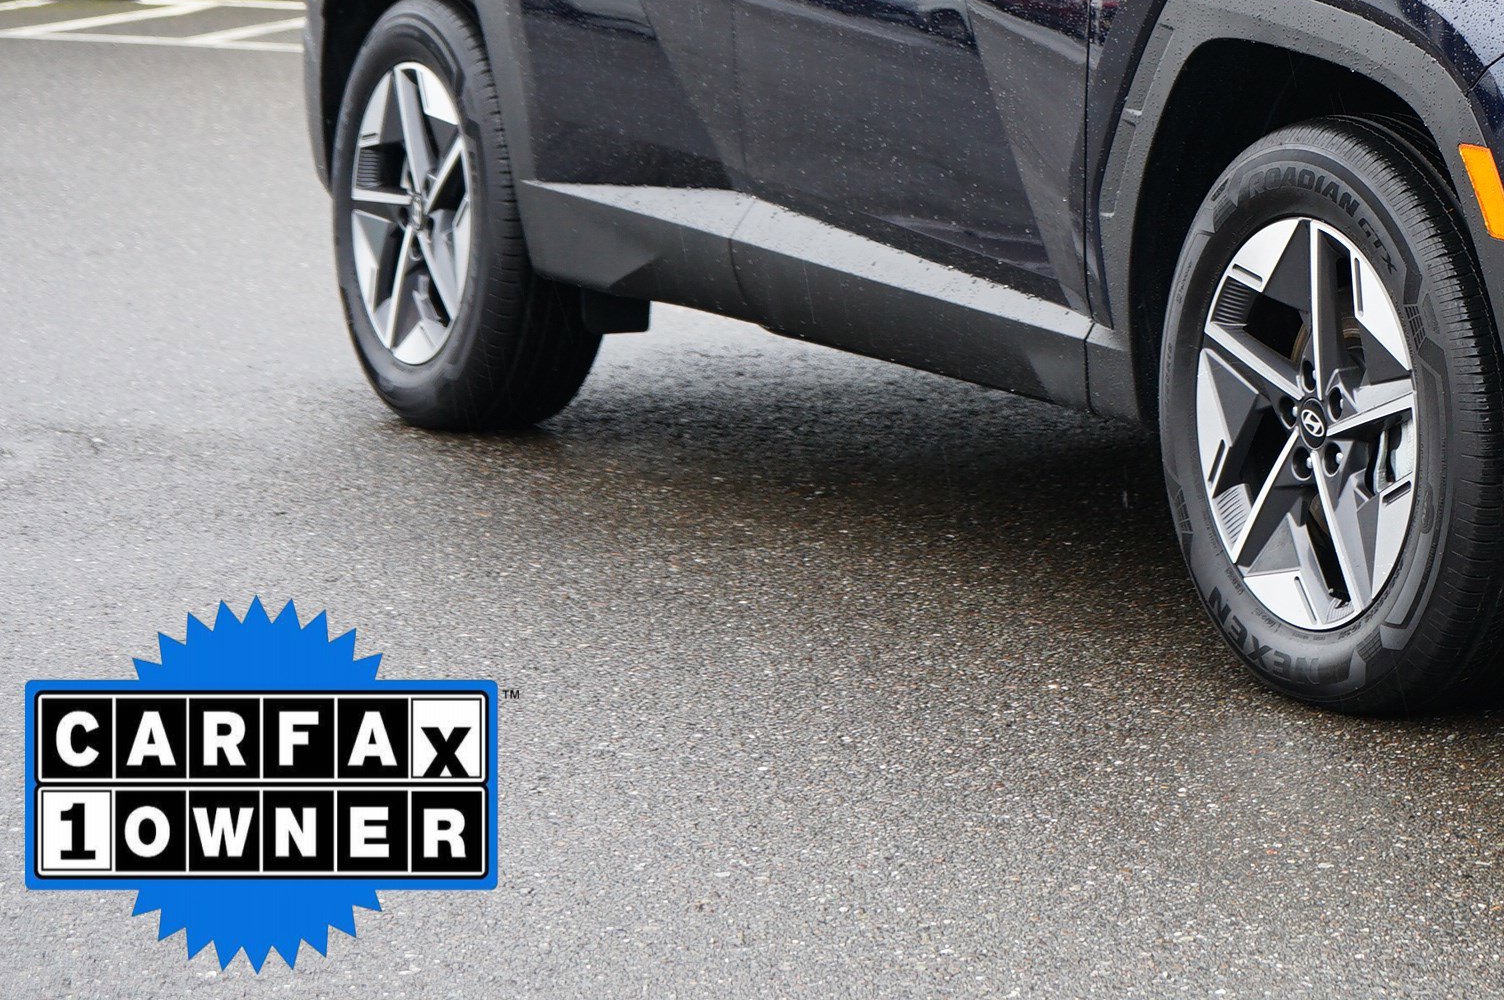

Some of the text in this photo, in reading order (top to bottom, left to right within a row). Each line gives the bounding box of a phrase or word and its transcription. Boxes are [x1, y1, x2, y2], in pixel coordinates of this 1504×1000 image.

[1247, 166, 1398, 275] ROADIAN GTX
[1207, 586, 1320, 686] NEXEN
